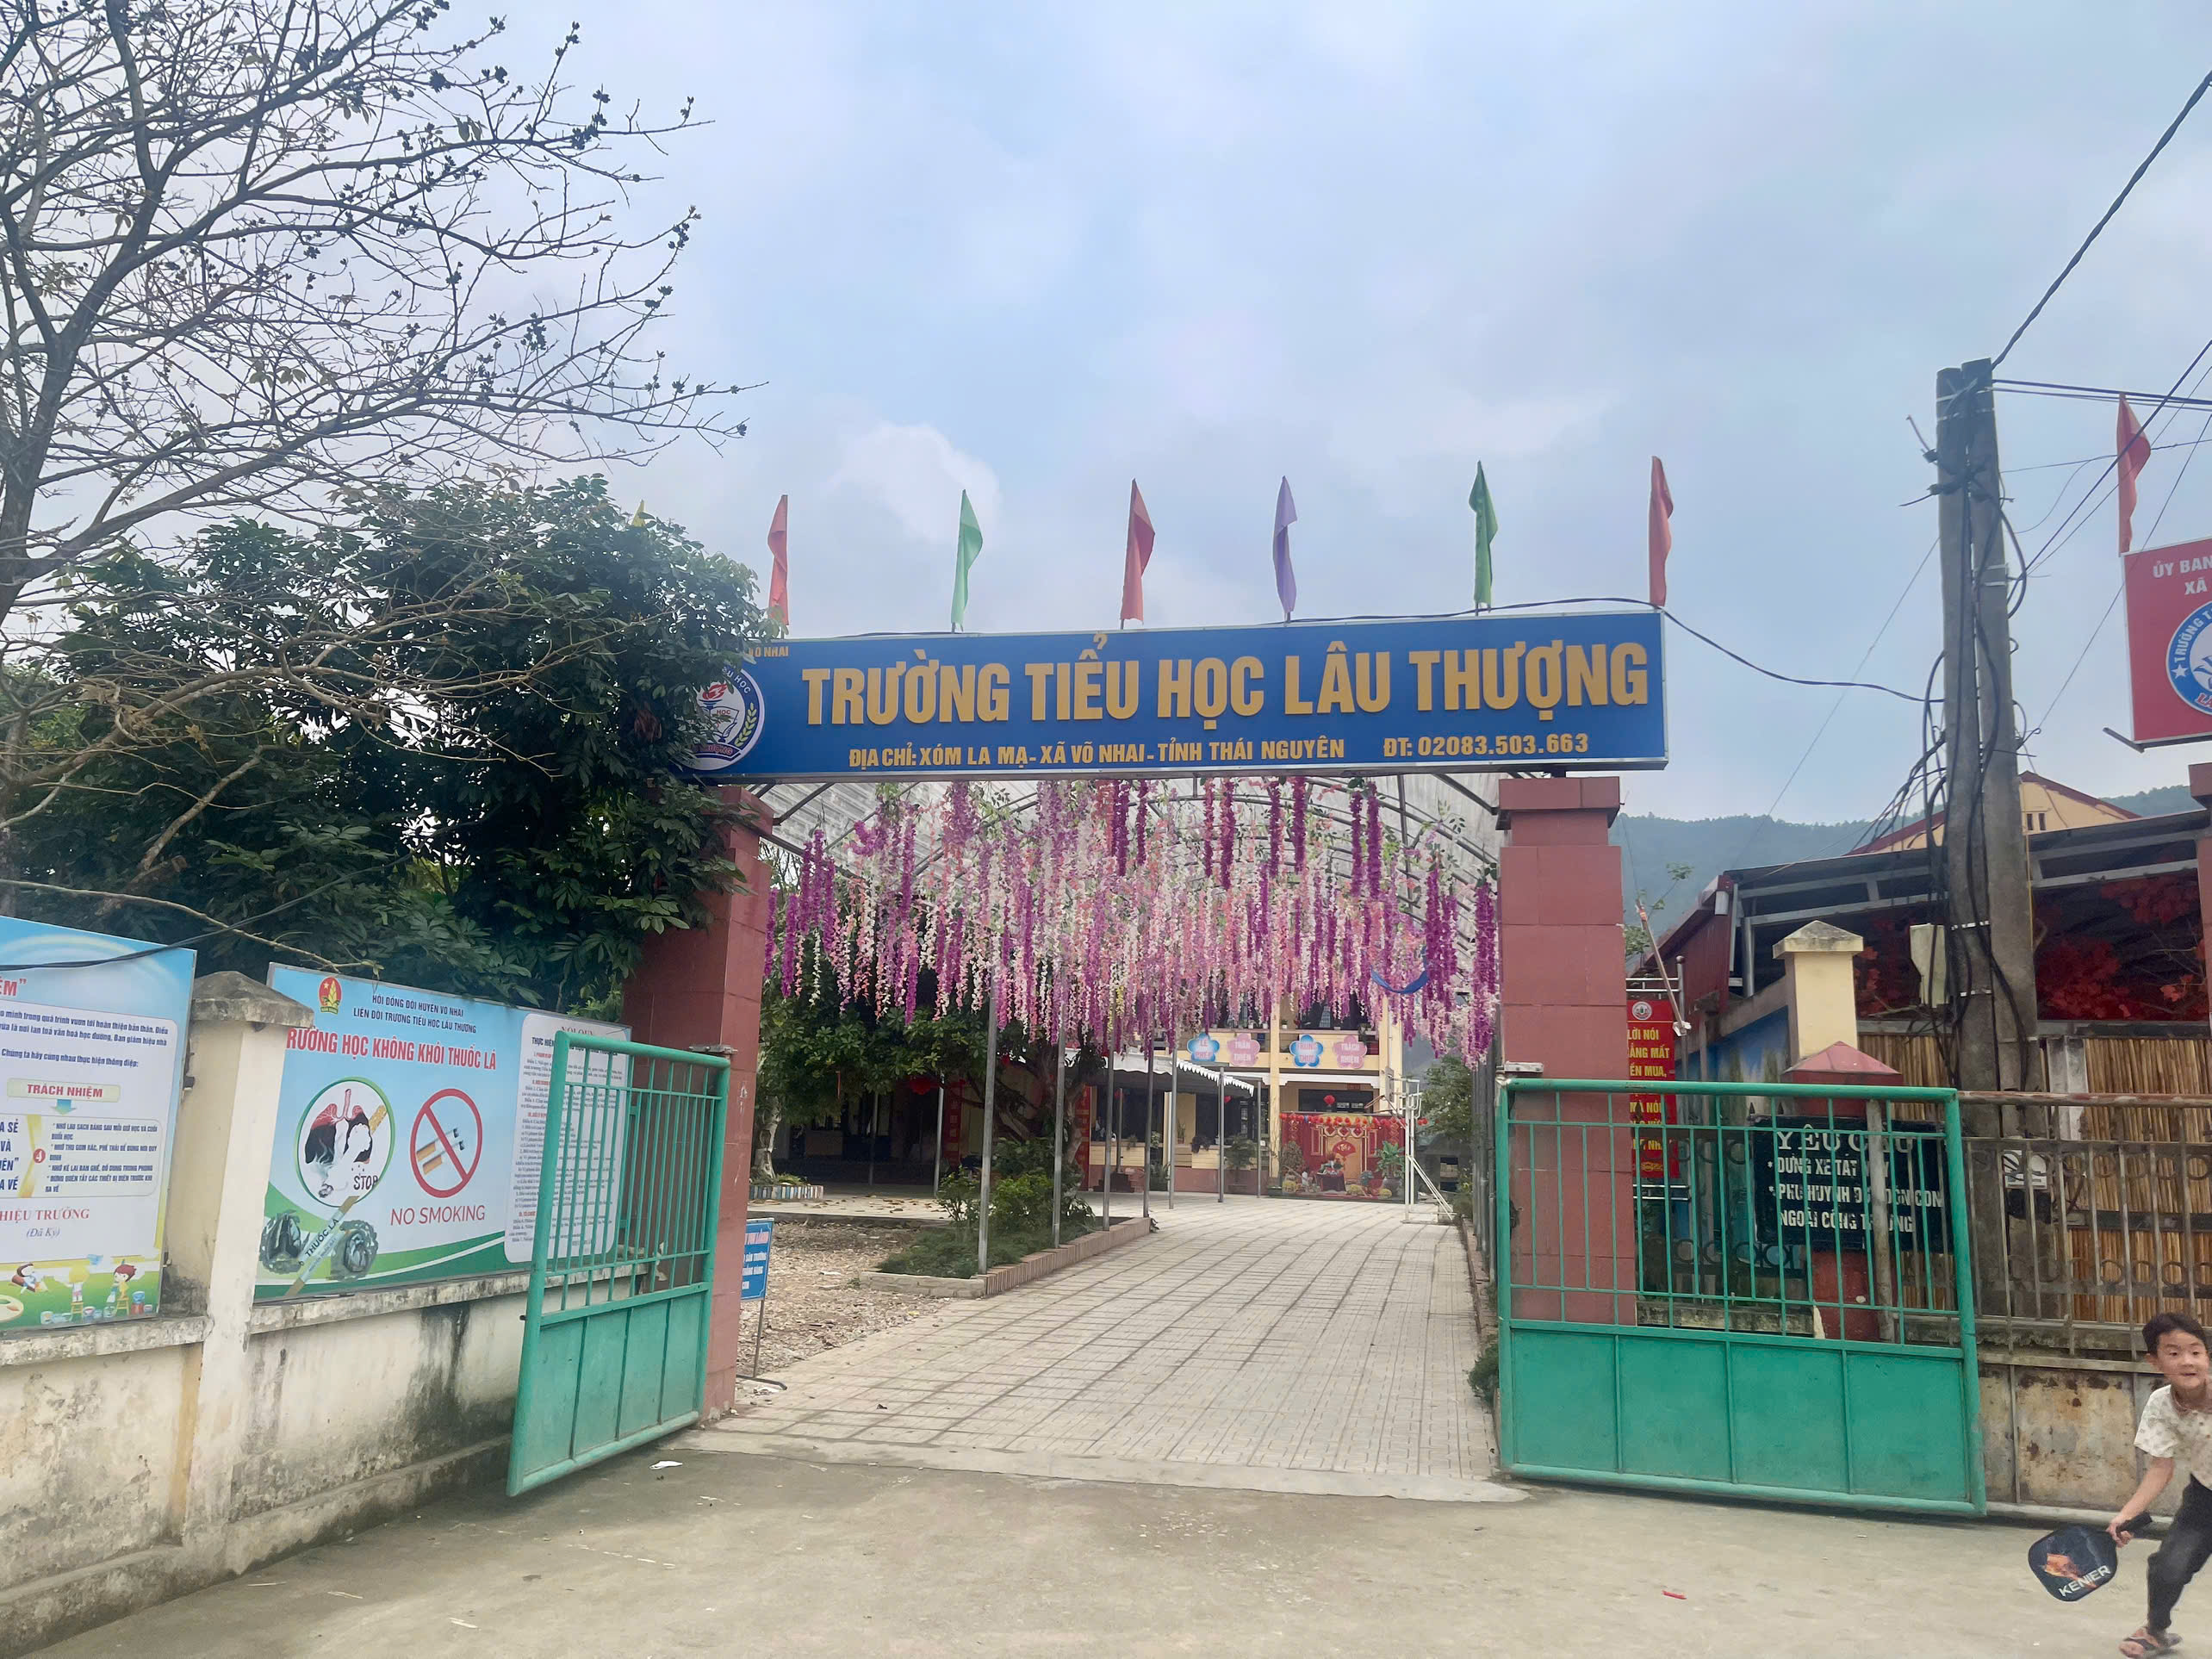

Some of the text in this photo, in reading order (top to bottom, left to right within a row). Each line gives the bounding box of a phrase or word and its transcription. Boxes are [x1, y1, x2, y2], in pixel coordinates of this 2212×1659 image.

[2153, 556, 2212, 578] ỦY BAN
[2184, 577, 2207, 595] XÃ
[2174, 618, 2204, 663] TRƯỜNG
[764, 646, 789, 657] NHAI
[802, 633, 1648, 730] TRƯỜNG TIỂU HỌC LÂU THƯỢNG
[849, 749, 879, 770] ĐỊA
[919, 743, 961, 766] XÓM
[967, 747, 991, 765] LA
[1041, 741, 1066, 764] XÃ
[1071, 741, 1094, 764] VÕ
[1158, 737, 1202, 761] TỈNH
[1209, 737, 1252, 761] THÁI
[1261, 735, 1345, 759] NGUYÊN
[1383, 737, 1413, 757] ĐT:
[23, 1013, 40, 1022] trong
[449, 1006, 463, 1017] NHAI
[1627, 1027, 1659, 1041] LỜI NÓI
[2, 1048, 22, 1059] Chúng
[286, 1026, 338, 1053] RƯỜNG
[342, 1035, 369, 1060] HỌC
[372, 1036, 414, 1062] KHÔNG
[418, 1041, 444, 1065] KHÓI
[448, 1043, 481, 1069] THUỐC
[484, 1049, 496, 1070] LÁ
[1650, 1043, 1669, 1059] MẤT
[28, 1080, 103, 1100] TRÁCH NHIỆM
[1815, 1158, 1833, 1176] XE
[0, 1209, 32, 1223] HIỆU
[390, 1204, 486, 1226] NO SMOKING
[2059, 1565, 2111, 1597] KENIER
